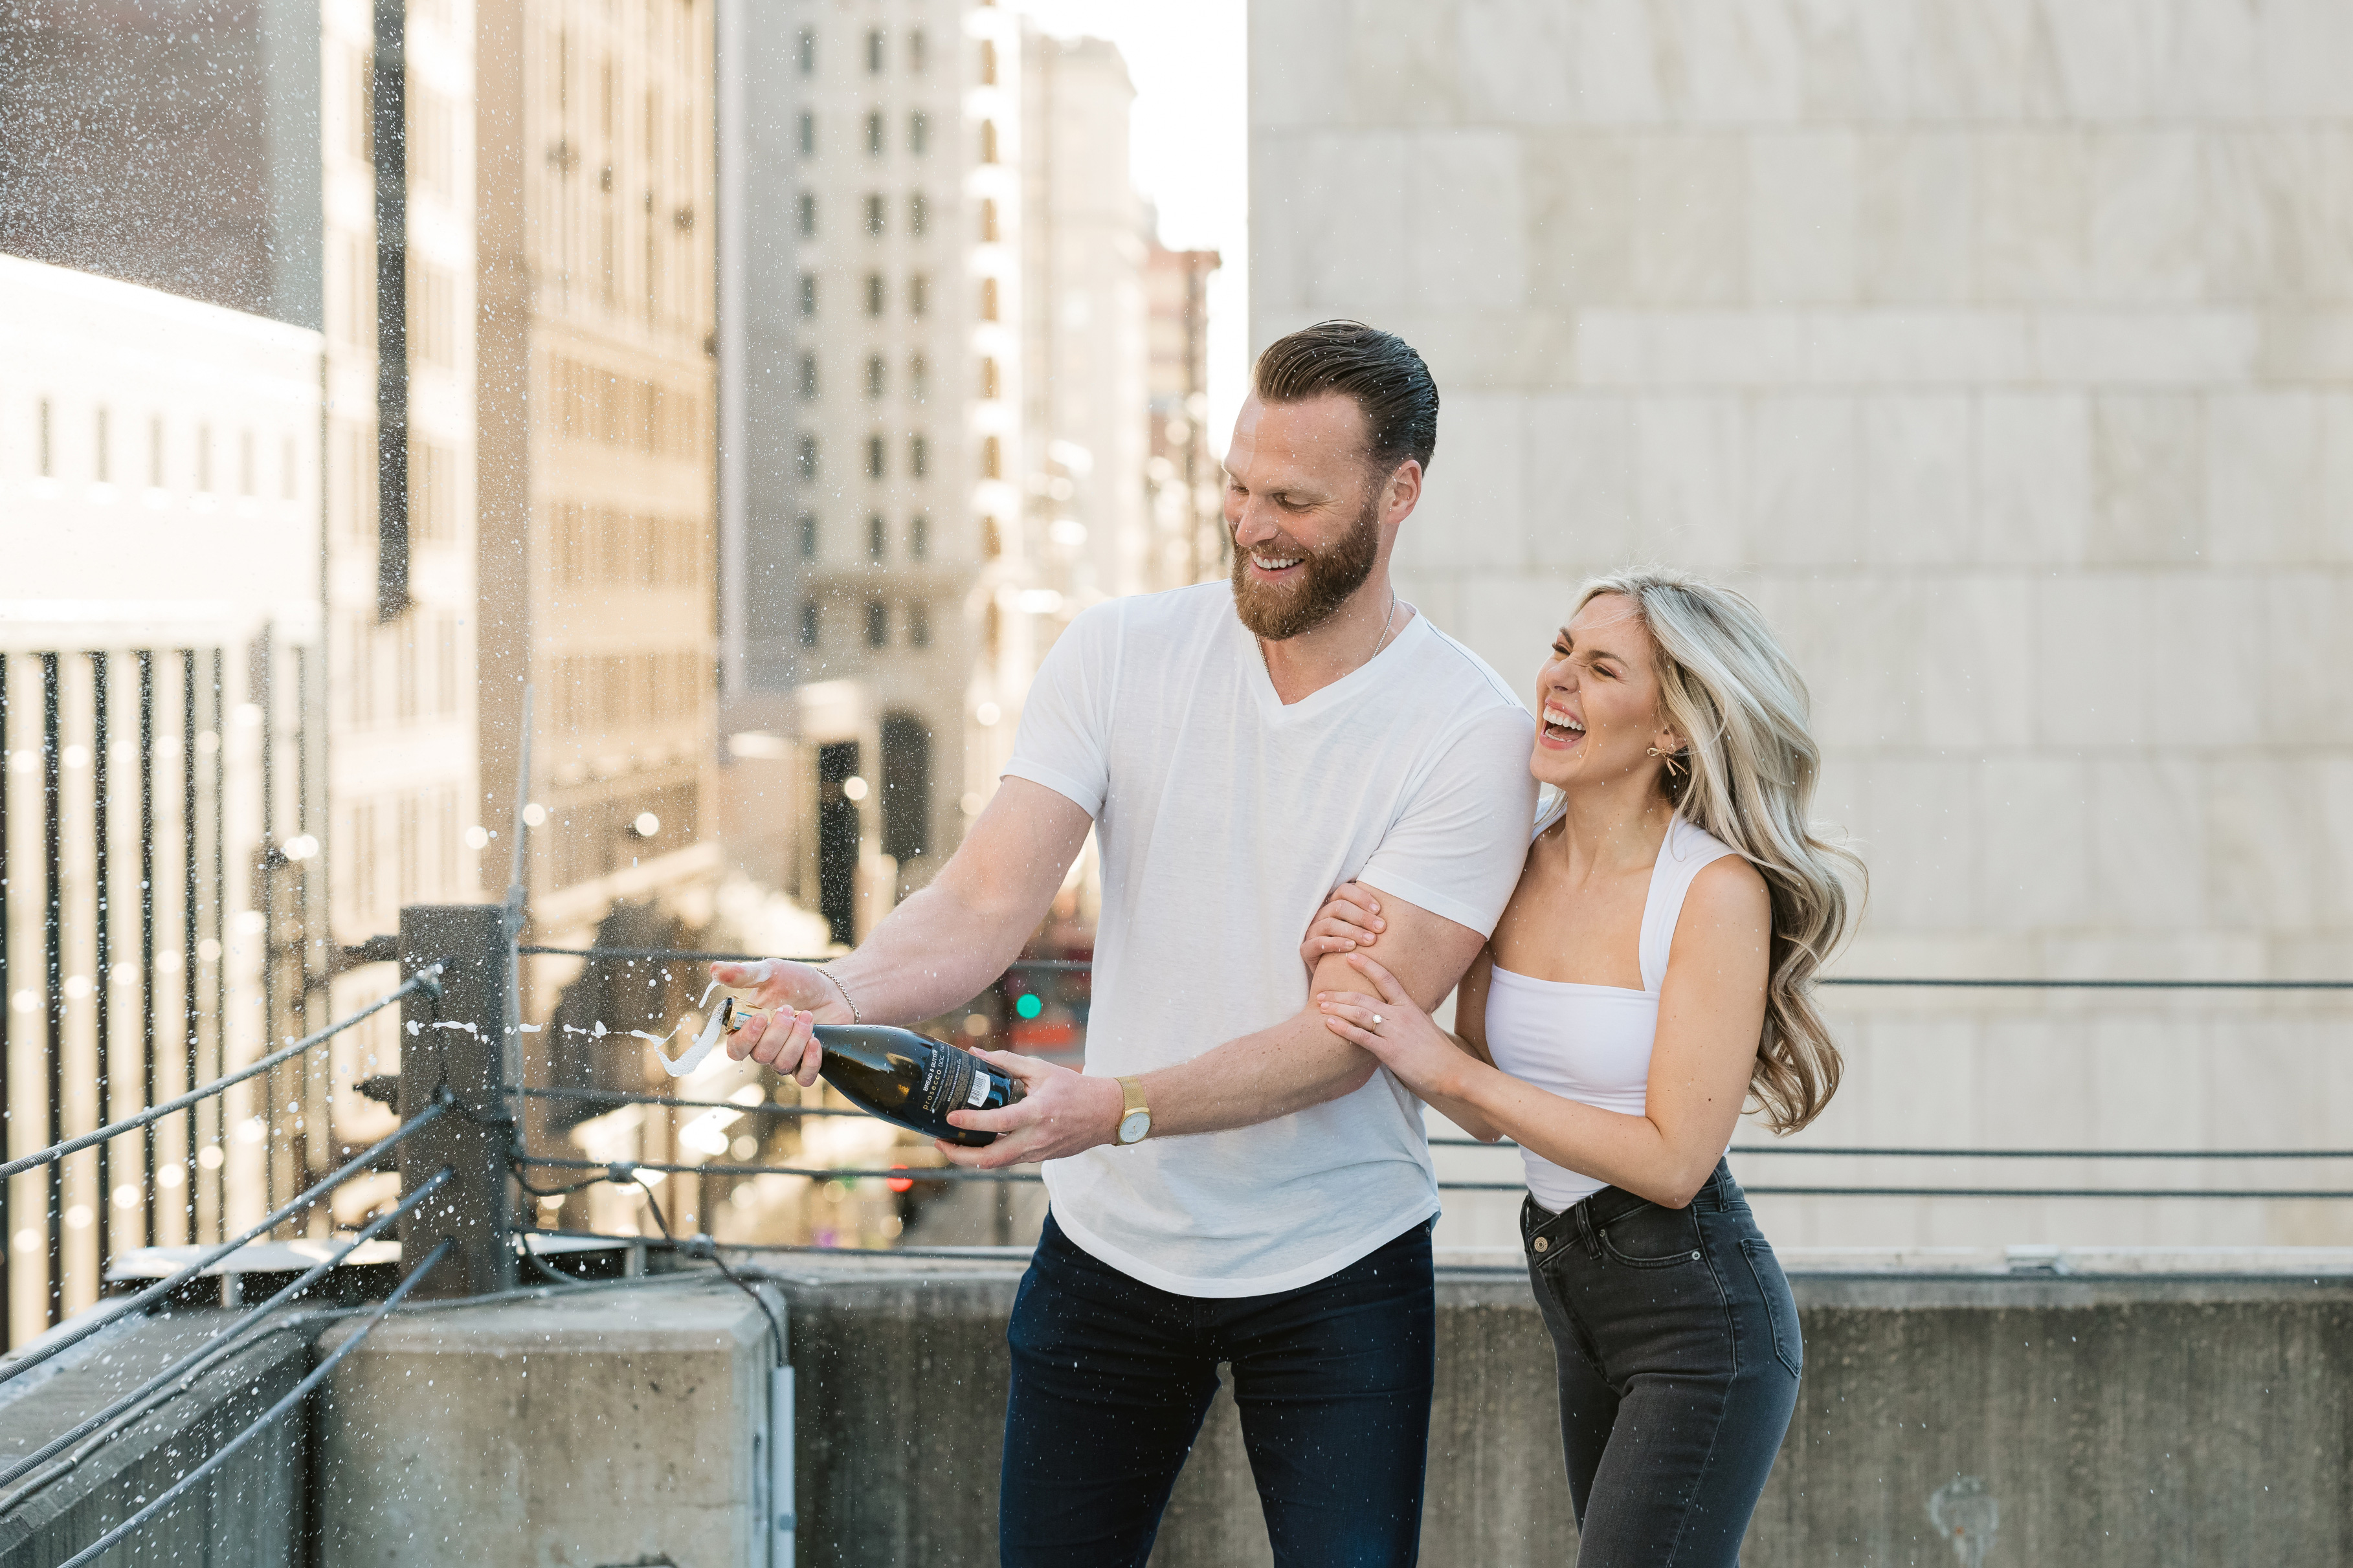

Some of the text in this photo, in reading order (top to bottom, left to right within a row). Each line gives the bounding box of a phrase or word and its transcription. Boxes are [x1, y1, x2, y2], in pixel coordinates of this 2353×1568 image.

[922, 1070, 941, 1110] prosecco
[923, 1073, 933, 1092] BREAD
[947, 1059, 961, 1102] BREADANDBUTTERWINES.COM
